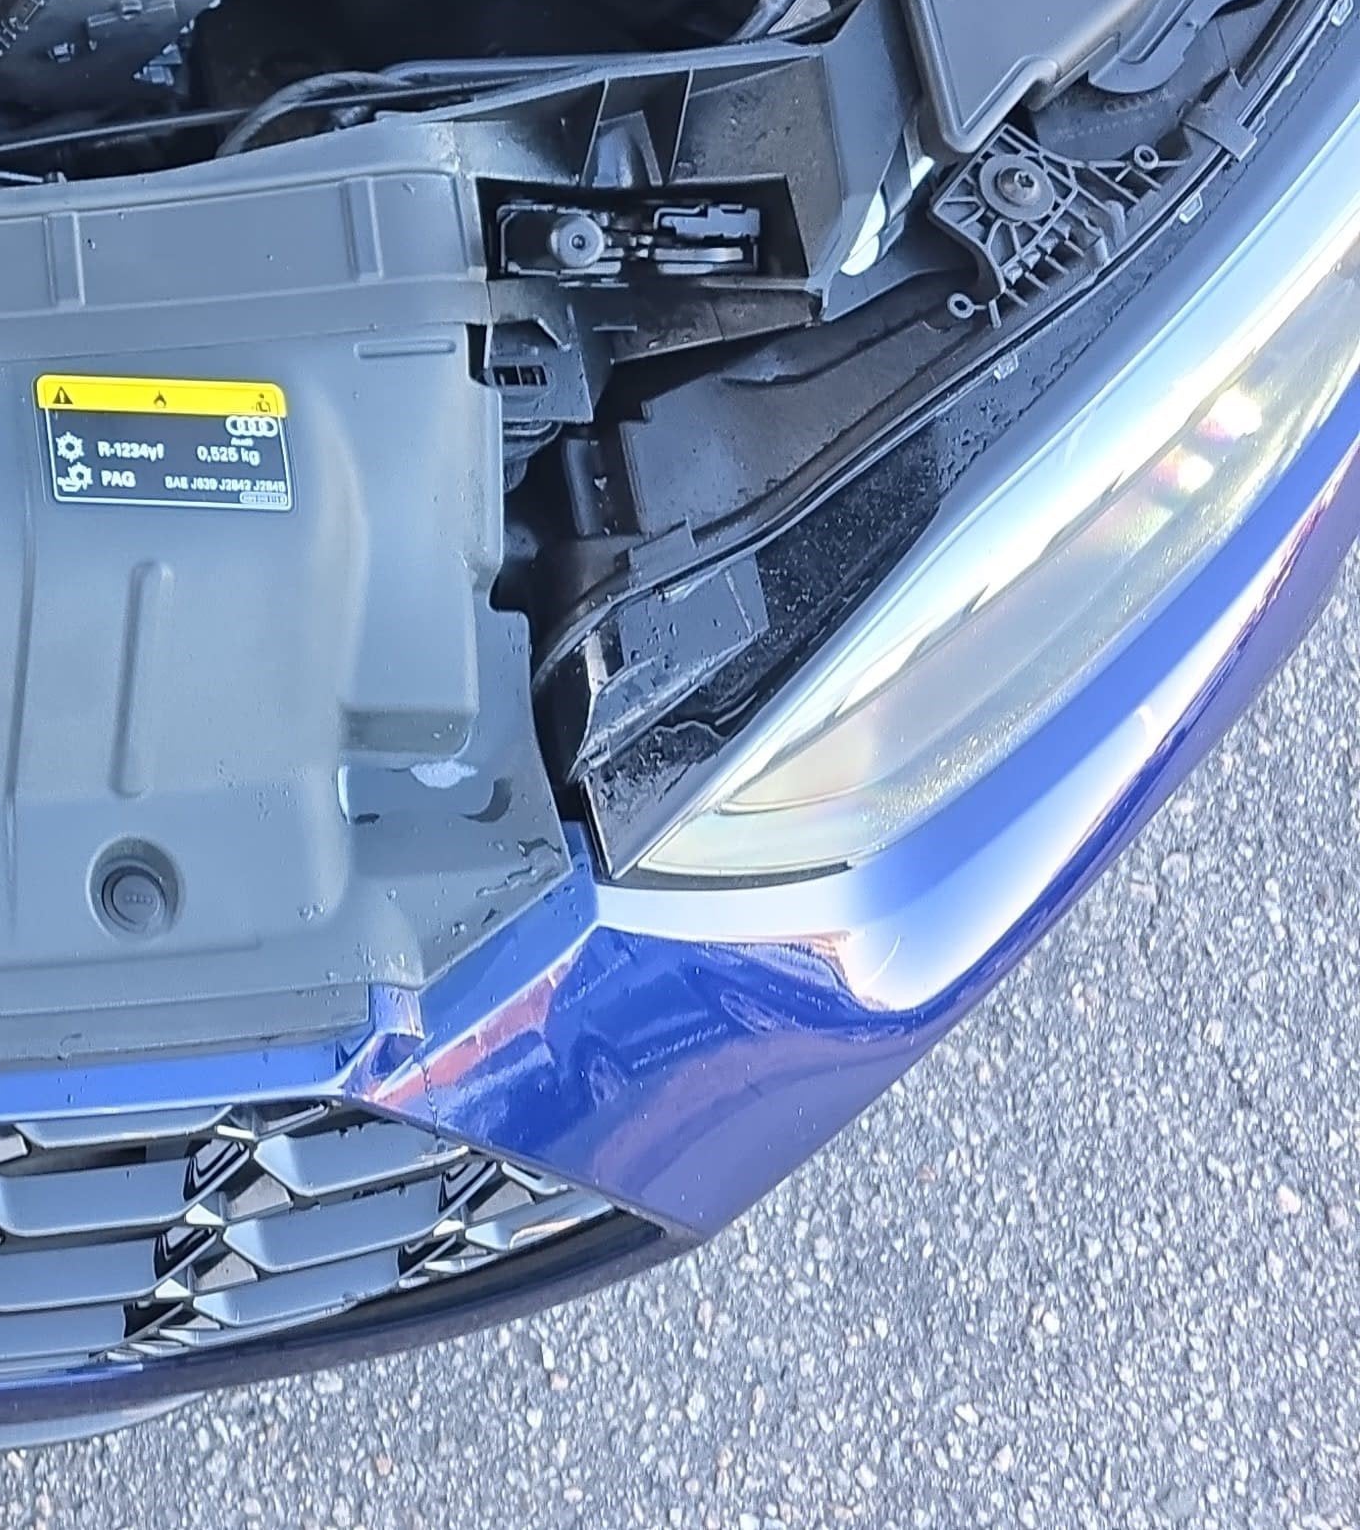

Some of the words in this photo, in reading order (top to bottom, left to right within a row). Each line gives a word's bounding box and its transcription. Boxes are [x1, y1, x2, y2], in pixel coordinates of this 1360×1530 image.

[97, 441, 165, 462] R-1234yf
[240, 447, 261, 467] kg
[100, 470, 137, 488] PAG
